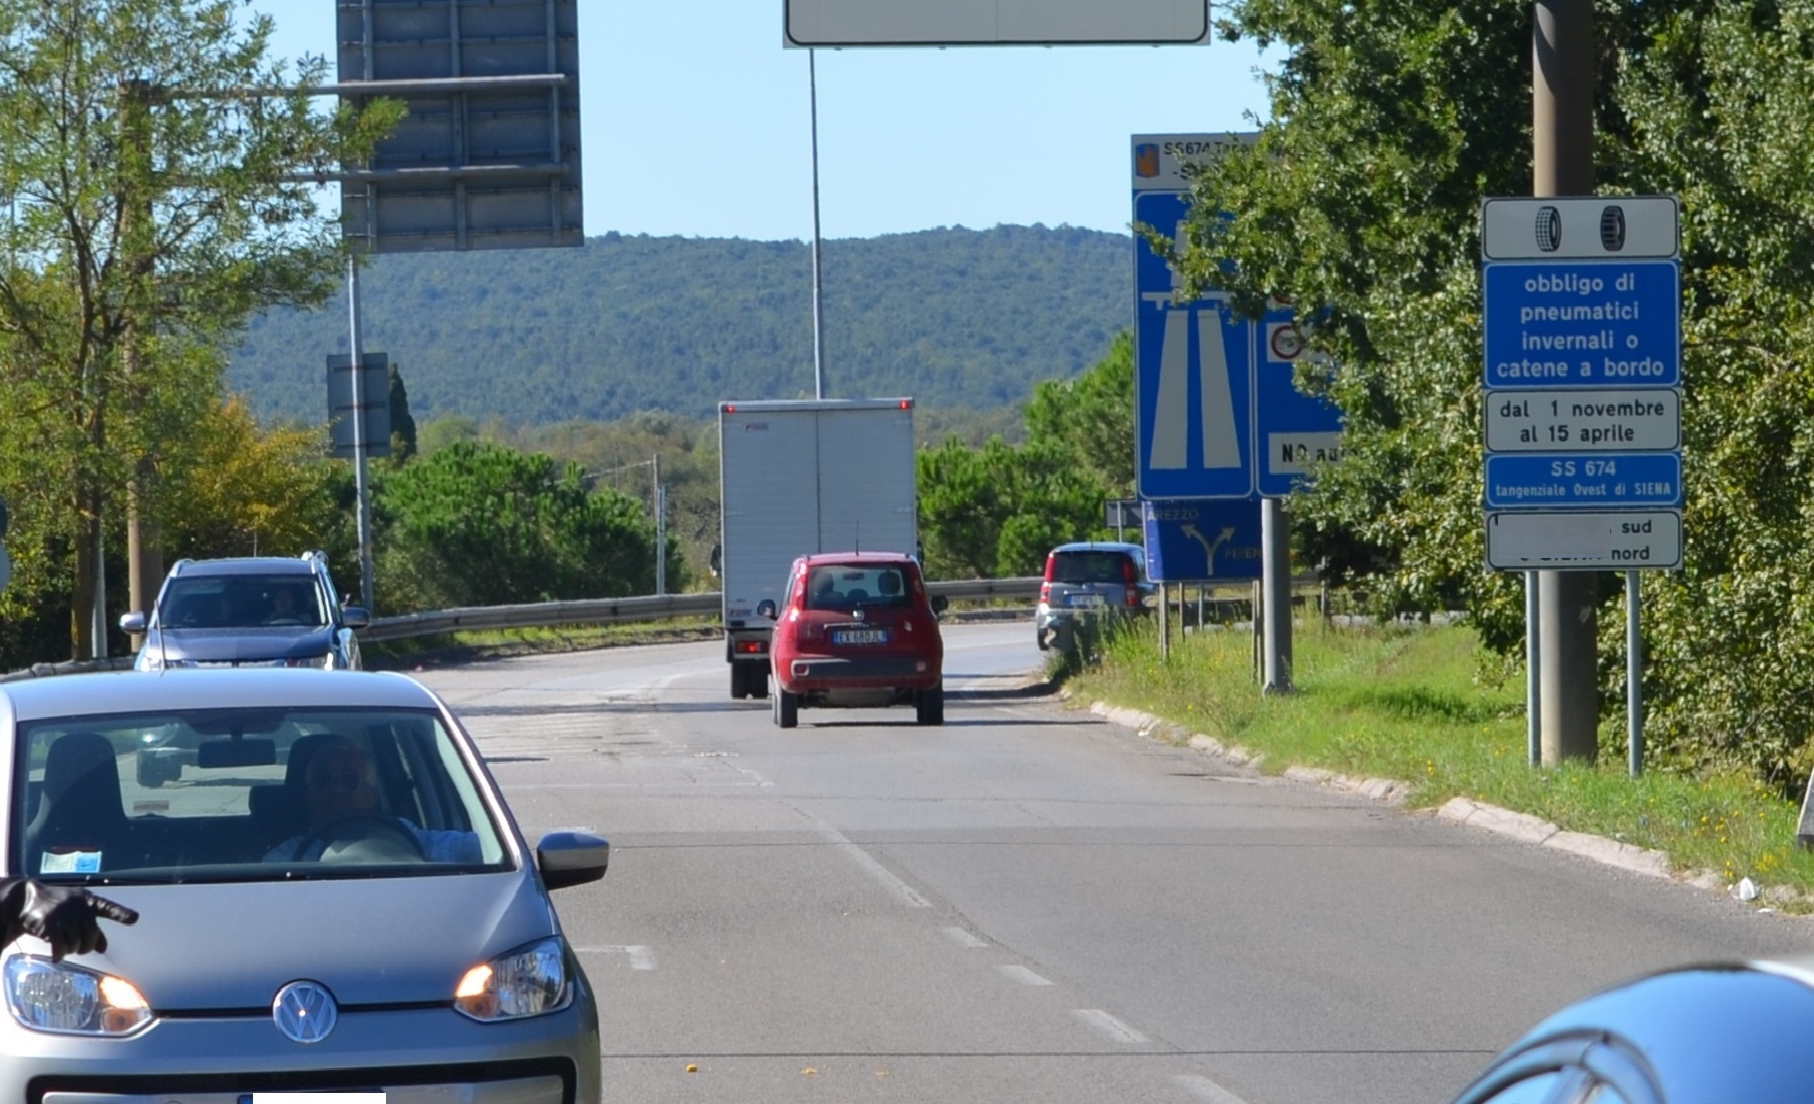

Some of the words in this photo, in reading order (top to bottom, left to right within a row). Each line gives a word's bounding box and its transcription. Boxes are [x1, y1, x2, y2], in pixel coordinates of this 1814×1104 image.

[1524, 273, 1603, 295] obbligo
[1615, 272, 1635, 292] di
[1520, 302, 1639, 324] pneumatici
[1522, 329, 1614, 350] invernali
[1626, 335, 1638, 350] o
[1497, 360, 1568, 379] catene
[1580, 363, 1592, 378] a
[1603, 358, 1664, 377] bordo
[1499, 400, 1529, 418] dal
[1551, 400, 1558, 417] 1
[1572, 399, 1664, 417] novembre
[1520, 424, 1538, 443] al
[1548, 424, 1569, 442] 15
[1579, 424, 1635, 445] aprile
[1551, 461, 1576, 477] SS
[1585, 460, 1617, 476] 674
[1495, 482, 1566, 498] tangenziale
[1573, 482, 1607, 497] Ovest
[1614, 482, 1626, 496] di
[1634, 481, 1671, 496] SIENA
[1621, 520, 1652, 535] sud
[1225, 547, 1262, 559] FIREN
[1611, 545, 1650, 561] nord
